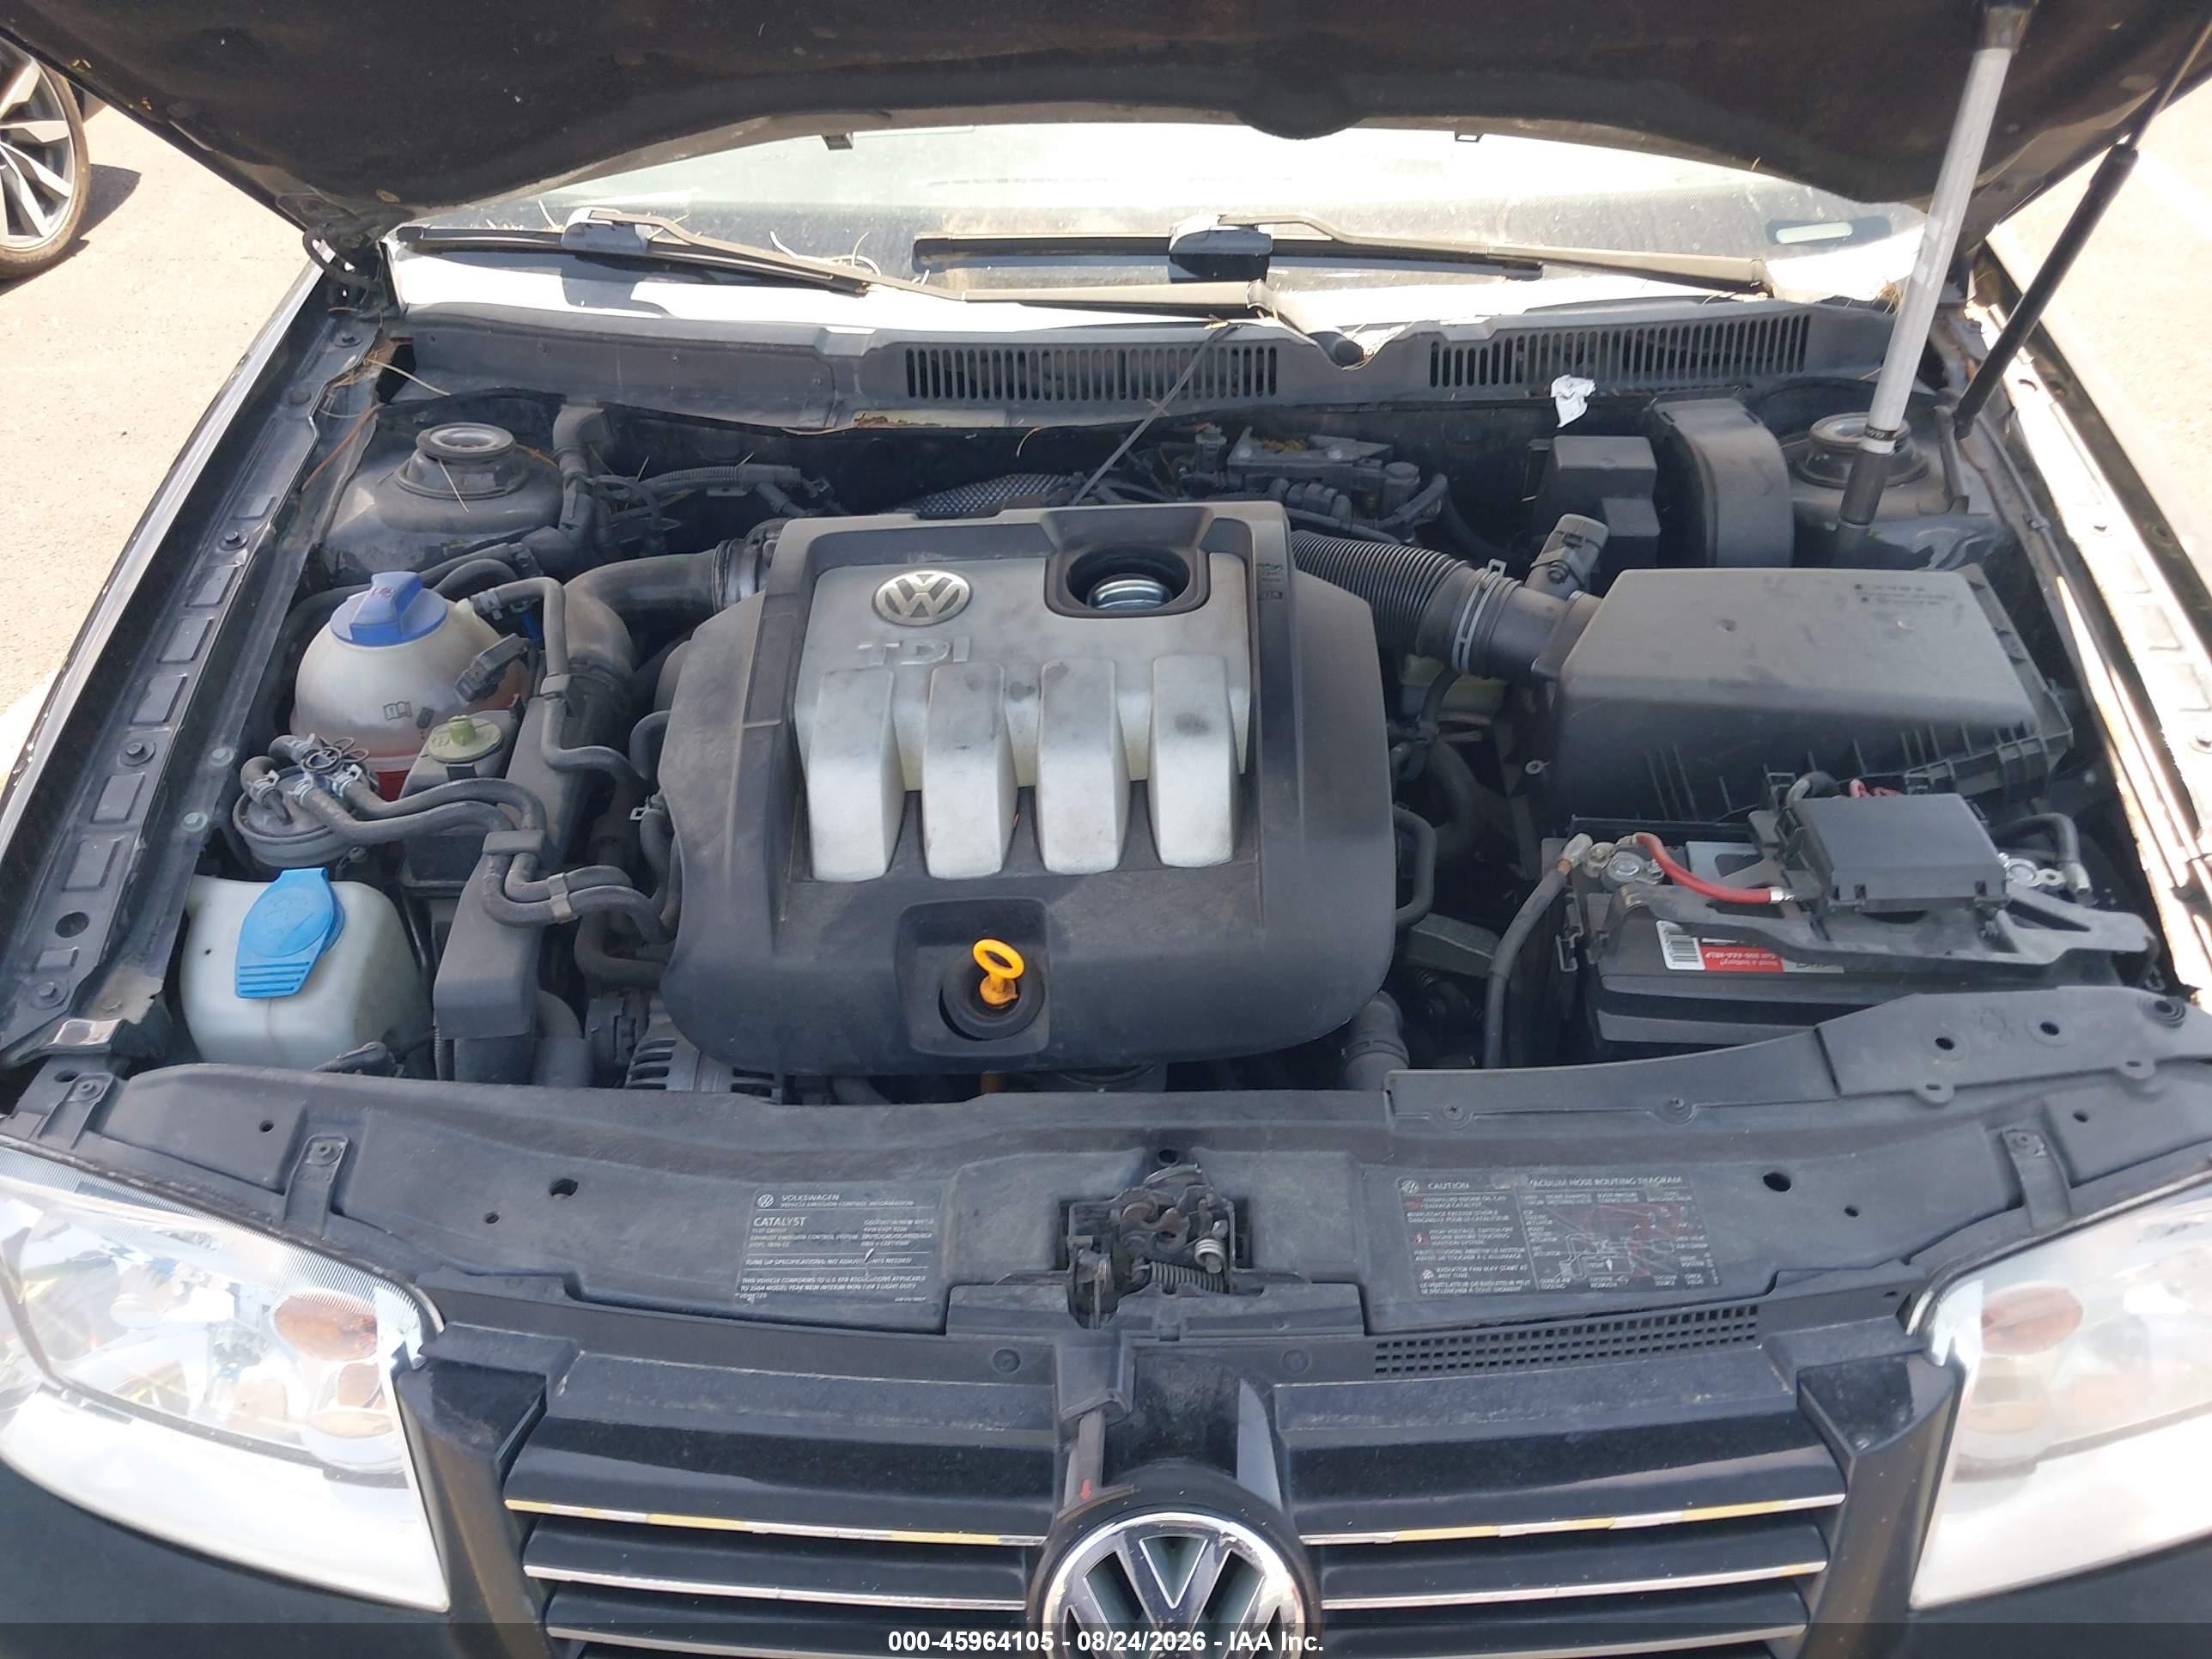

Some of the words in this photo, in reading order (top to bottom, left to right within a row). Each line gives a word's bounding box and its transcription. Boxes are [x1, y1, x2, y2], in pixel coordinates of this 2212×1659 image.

[858, 637, 970, 666] TDI
[1427, 1182, 1470, 1190] CAUTION
[1595, 1177, 1637, 1186] ROUTING
[1638, 1176, 1682, 1185] DIAGRAM
[753, 1216, 807, 1227] CATALYST
